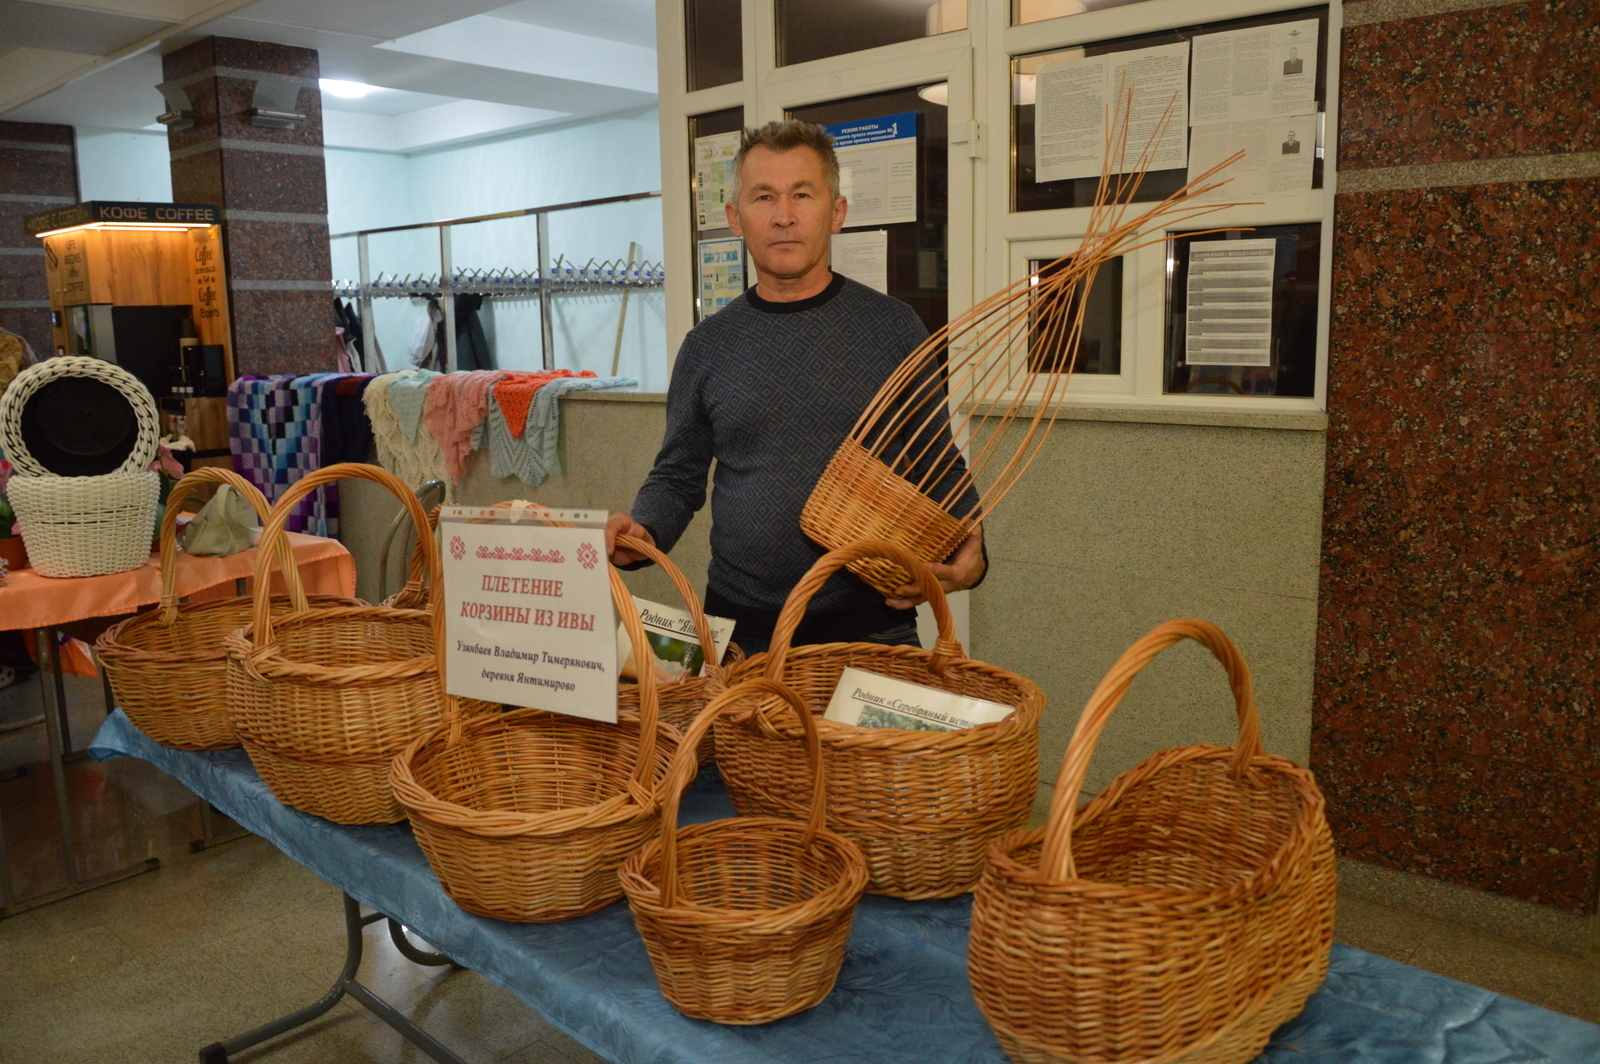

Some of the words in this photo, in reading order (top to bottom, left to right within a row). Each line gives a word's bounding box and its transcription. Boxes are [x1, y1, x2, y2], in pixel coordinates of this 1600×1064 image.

[100, 206, 148, 220] КОФЕ
[155, 207, 214, 221] COFFEE
[481, 574, 563, 597] ПЛЕТЕНИЕ
[460, 601, 531, 624] КОРЗИНЫ
[533, 608, 554, 626] ИЗ
[556, 611, 596, 631] ИВЫ
[640, 608, 675, 628] Родник
[457, 640, 492, 656] Узянбаев
[494, 646, 539, 664] Владимир
[542, 651, 605, 672] Тимерянович,
[481, 667, 514, 682] деревня
[516, 672, 575, 692] Янтимирово
[852, 688, 886, 704] Родник
[887, 698, 948, 721] «Серебряный
